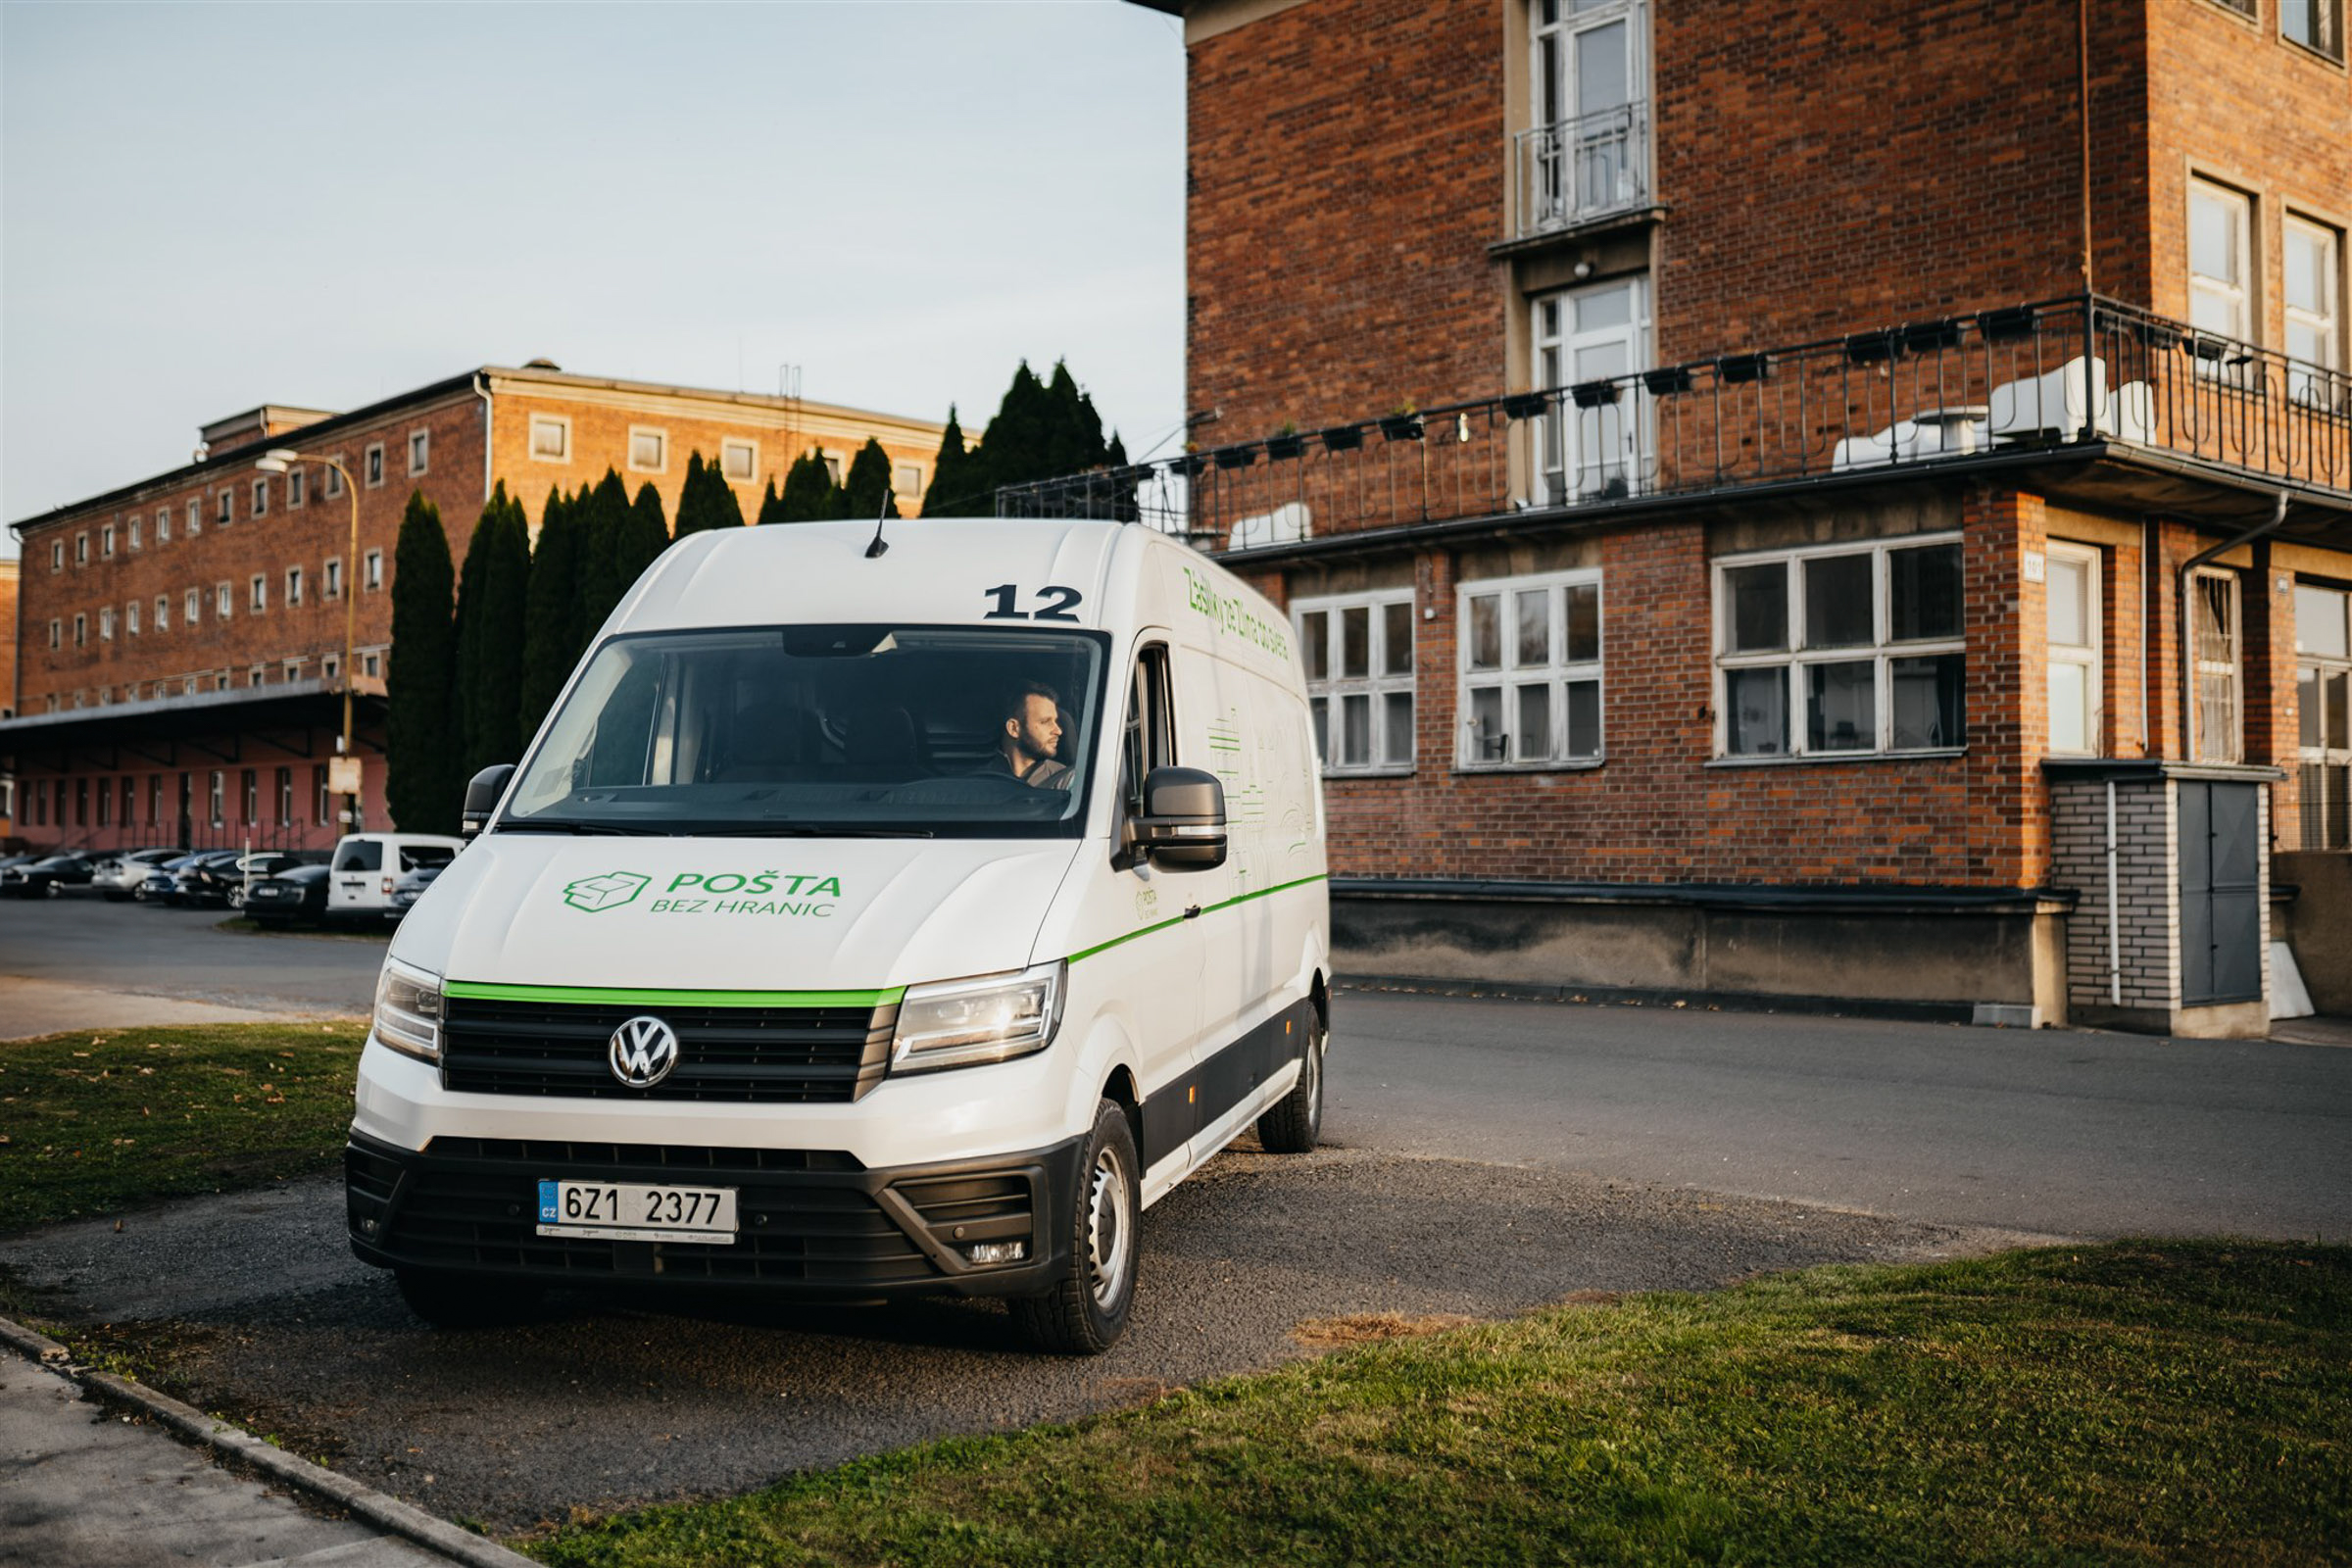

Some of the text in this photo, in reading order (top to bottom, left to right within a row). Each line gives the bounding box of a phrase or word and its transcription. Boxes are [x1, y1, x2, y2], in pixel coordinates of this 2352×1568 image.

[983, 584, 1083, 623] 12
[665, 869, 842, 898] POŠTA
[650, 899, 836, 917] BEZ HRANIC
[541, 1206, 558, 1219] CZ
[565, 1187, 721, 1225] 6Z1 2377
